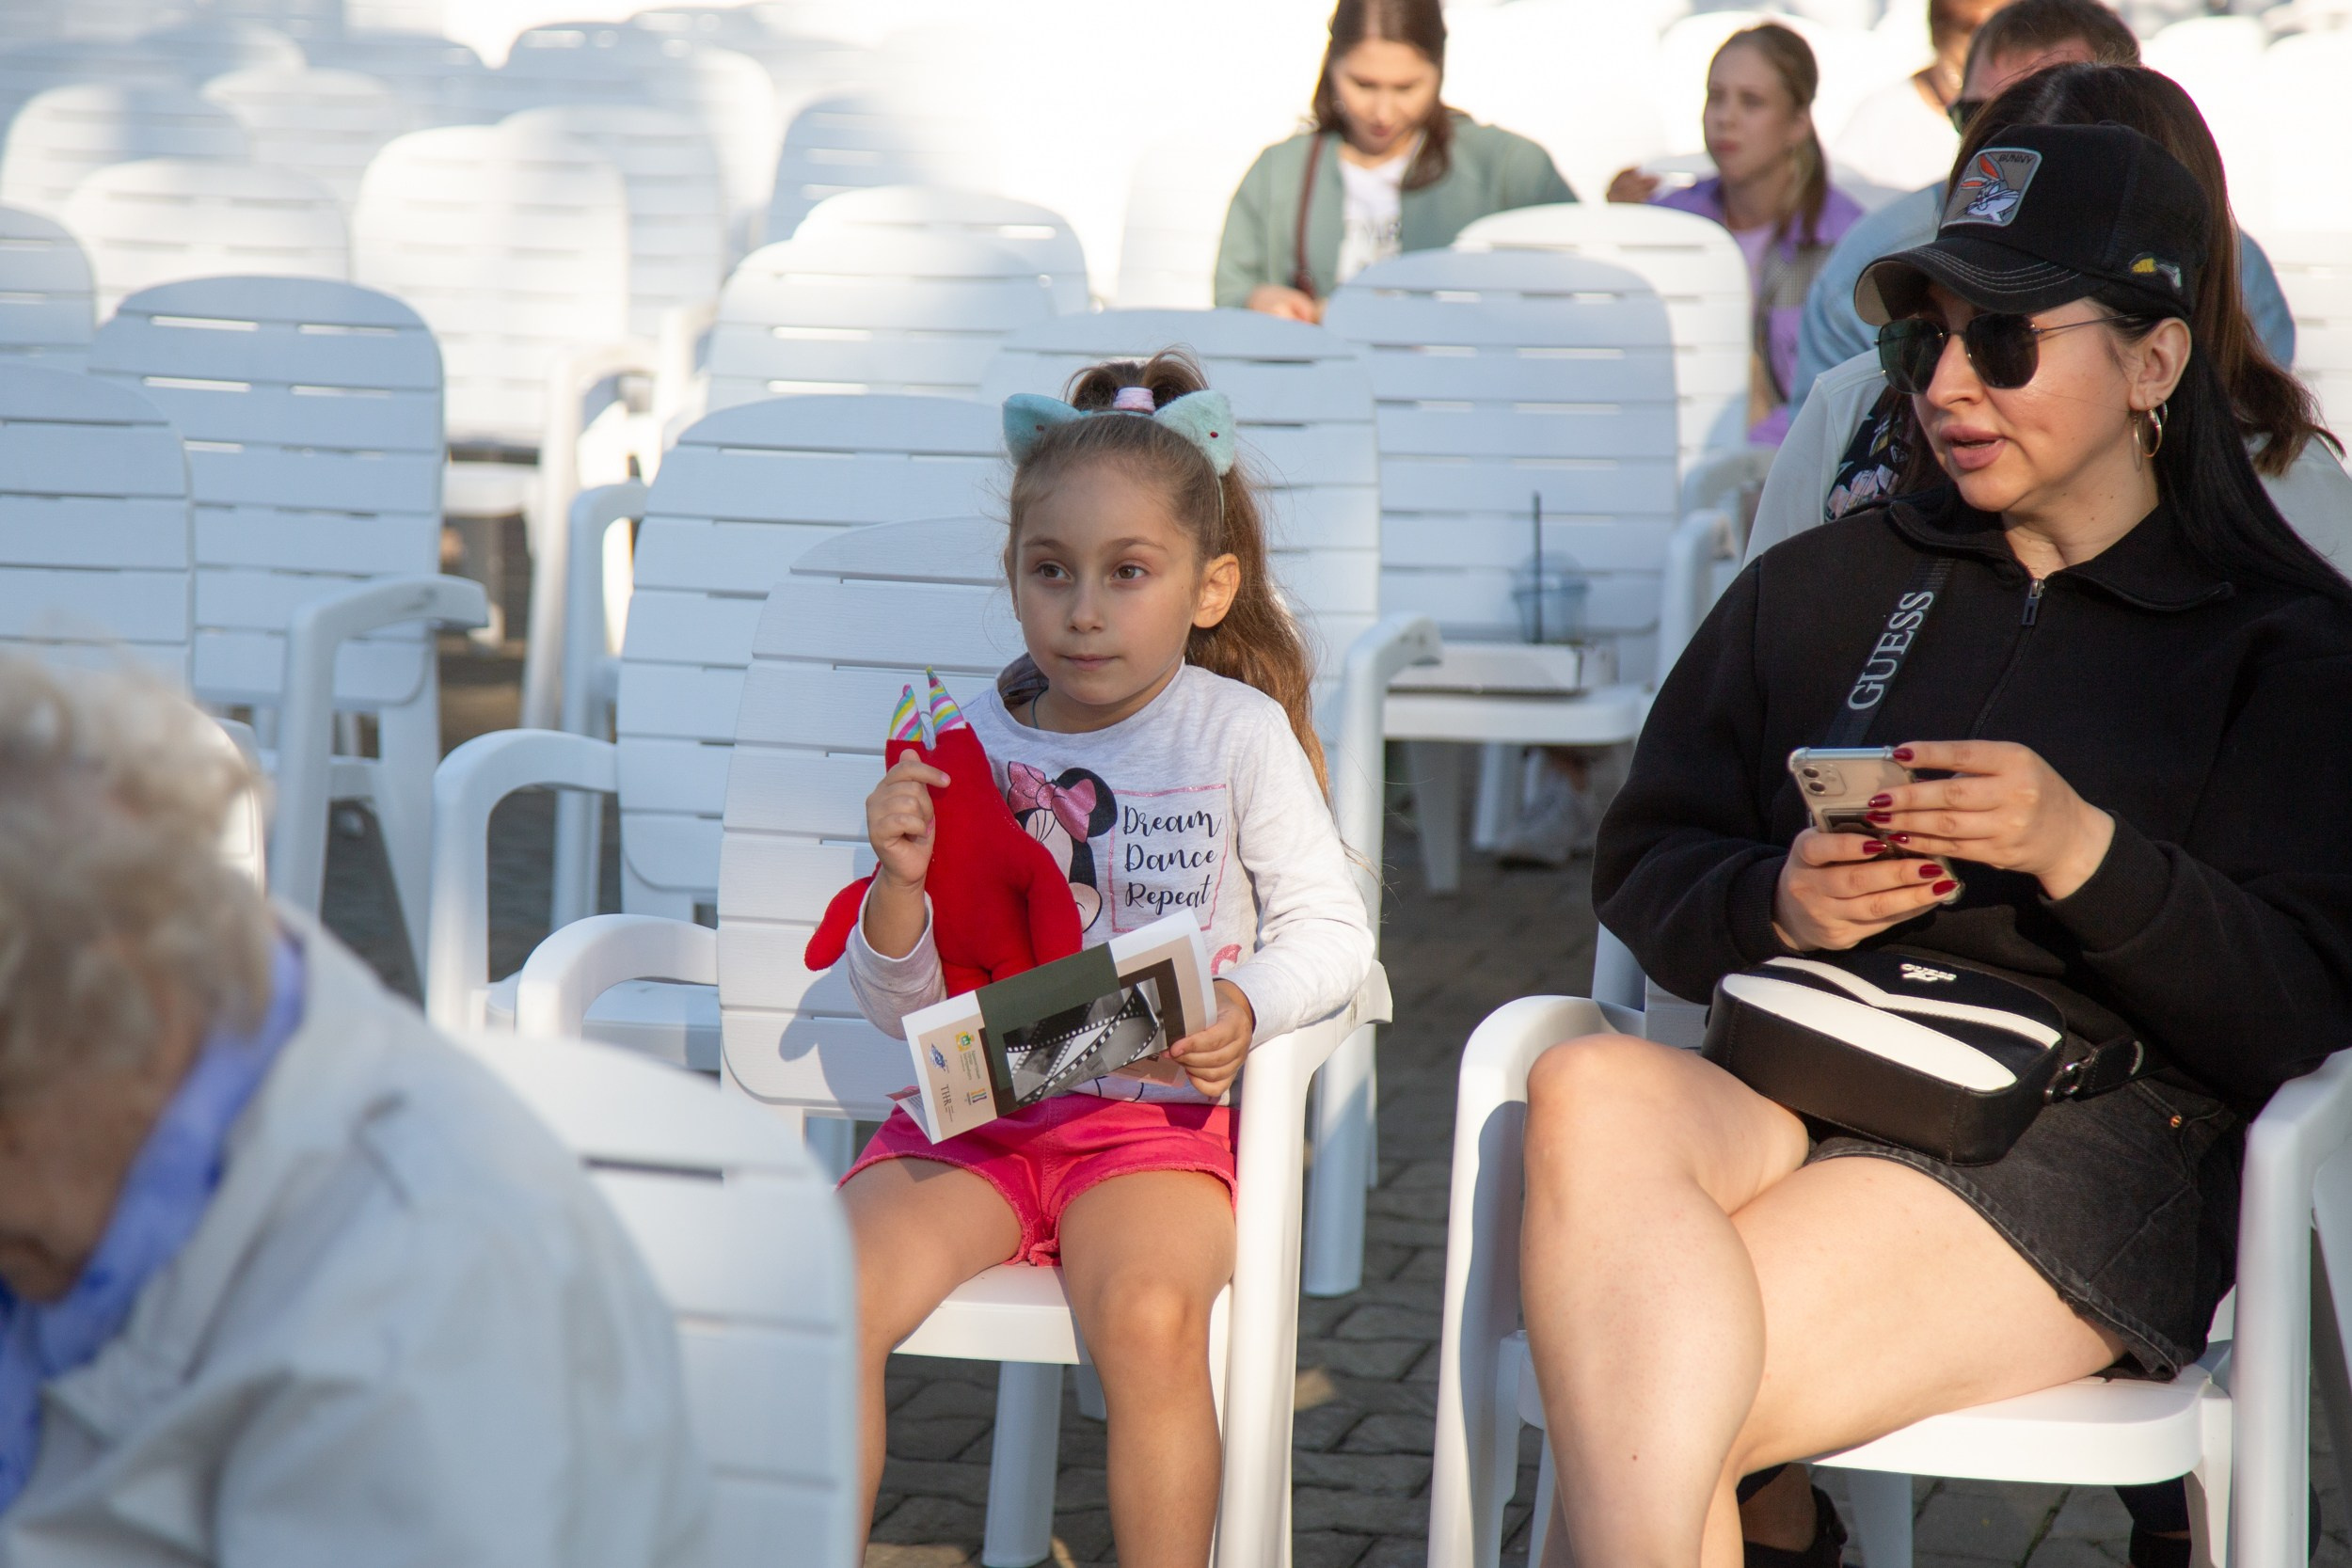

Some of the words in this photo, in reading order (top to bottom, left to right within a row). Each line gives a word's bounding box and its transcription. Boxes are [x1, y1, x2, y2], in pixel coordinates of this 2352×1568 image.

[1998, 153, 2034, 165] BUNNY
[1847, 591, 1934, 710] GUESS
[1122, 805, 1222, 838] Dream
[1124, 843, 1217, 872] Dance
[1125, 874, 1213, 915] Repeat
